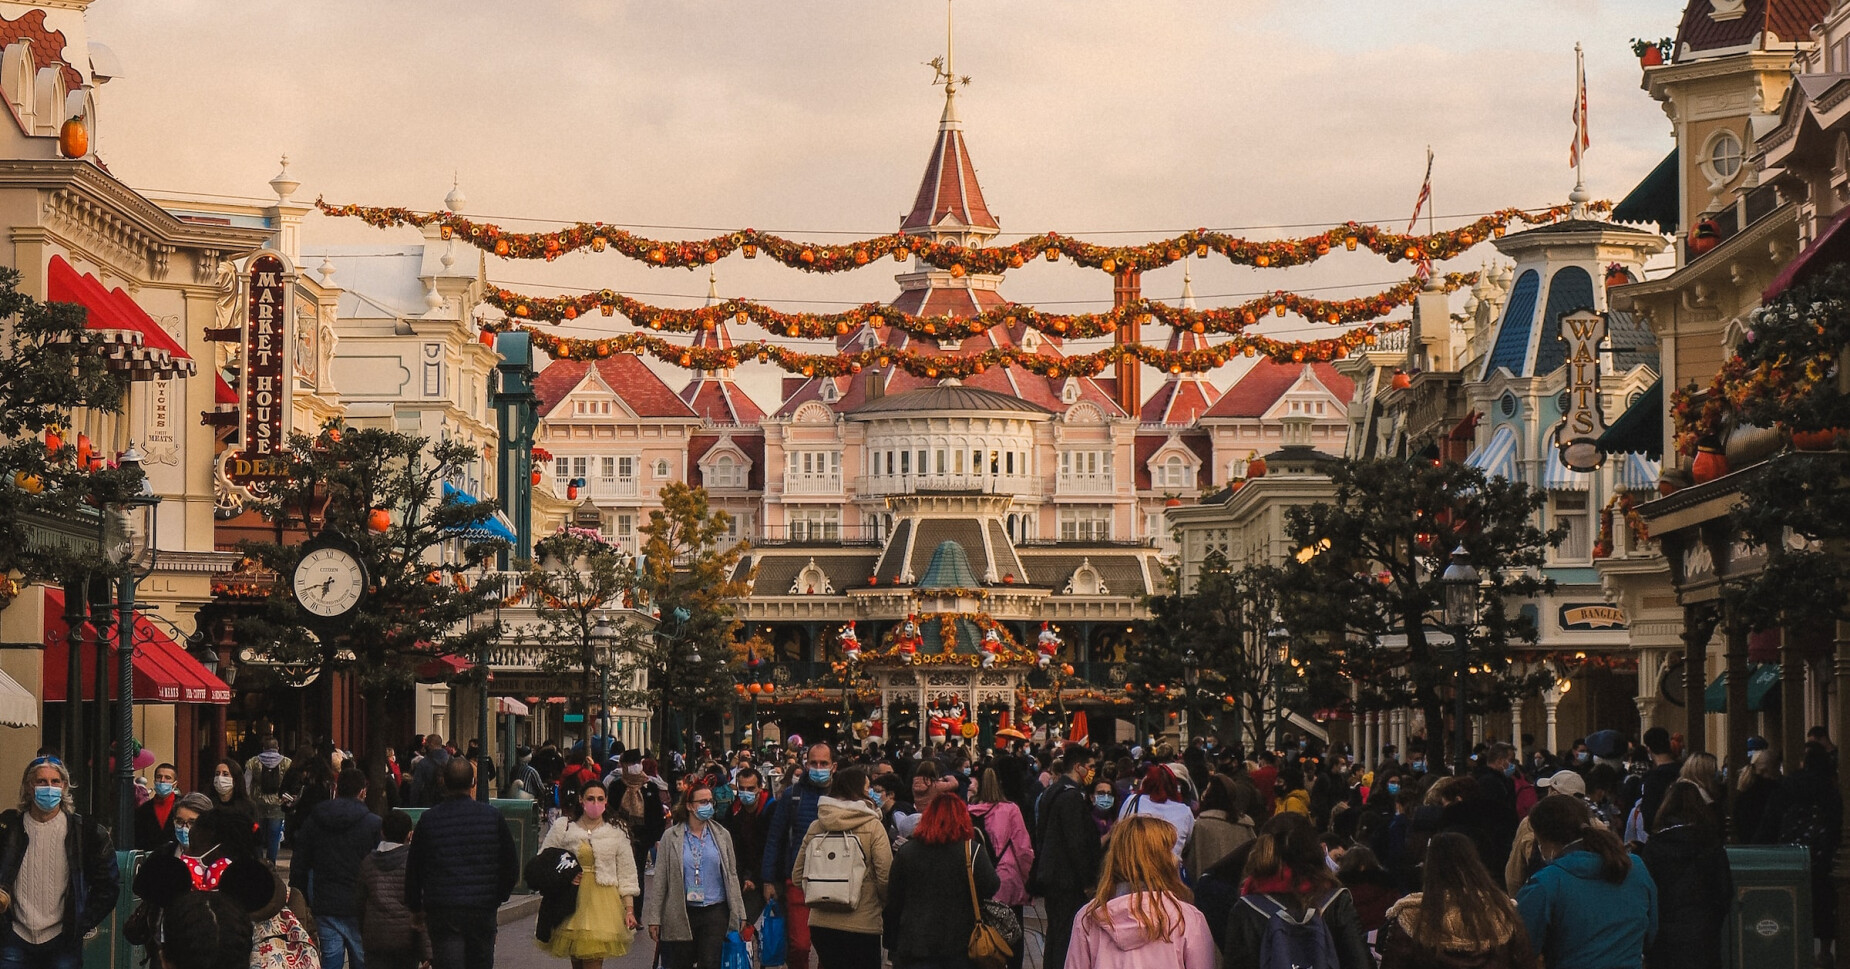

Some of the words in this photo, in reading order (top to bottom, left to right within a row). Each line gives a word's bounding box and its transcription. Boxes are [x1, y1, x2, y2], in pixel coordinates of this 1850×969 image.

[256, 271, 277, 366] MARKET
[256, 376, 274, 455] HOUSE
[1566, 319, 1598, 434] WALTS
